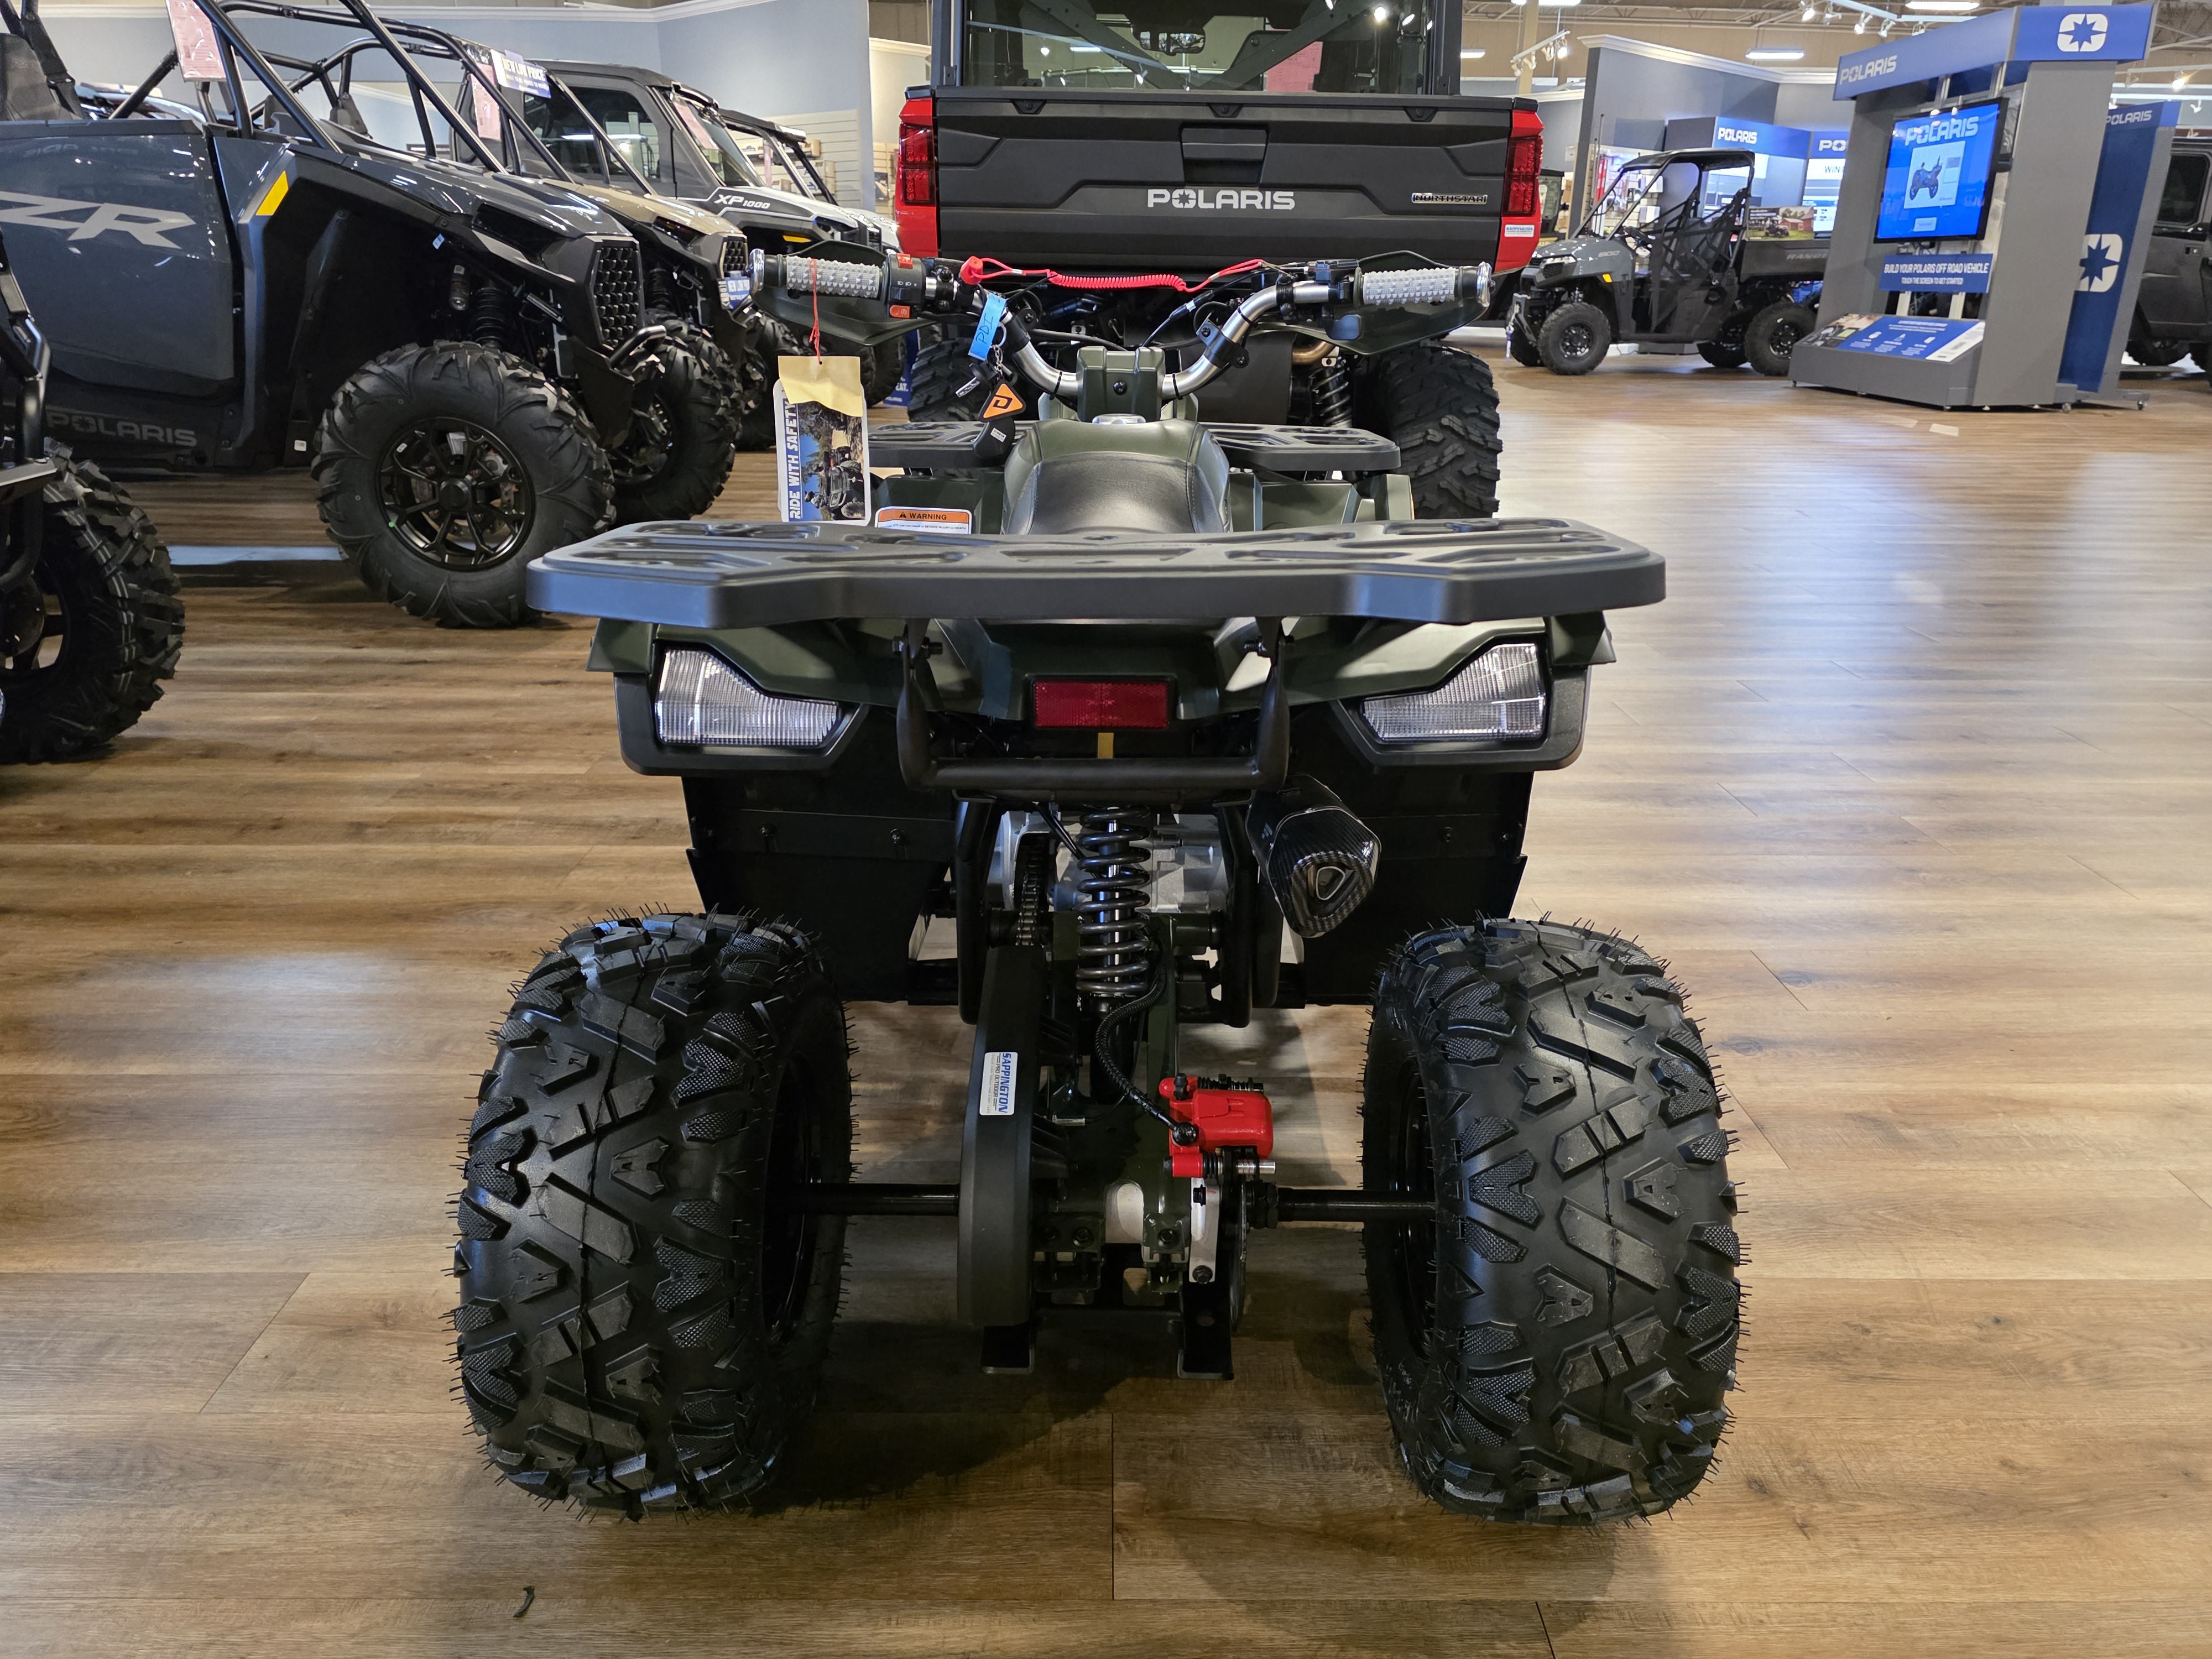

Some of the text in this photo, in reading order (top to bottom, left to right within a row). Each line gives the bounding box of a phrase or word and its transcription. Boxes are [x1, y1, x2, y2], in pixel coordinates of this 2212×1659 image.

[1840, 55, 1897, 85] POLARIS
[2106, 110, 2152, 125] POLARIS
[1718, 127, 1757, 144] POLARIS
[1905, 116, 1979, 146] POLARIS
[1819, 140, 1848, 151] PO
[714, 194, 771, 209] XP 1000
[1147, 189, 1295, 210] POLARIS
[1415, 194, 1483, 202] NORTHSTAR
[1884, 263, 1989, 274] BUILD YOUR POLARIS OFF ROAD VEHICLE
[976, 313, 993, 344] PDI
[45, 412, 197, 447] POLARIS
[784, 401, 801, 519] RIDE WITH SAFETY
[998, 1053, 1011, 1113] SAPPINGTON
